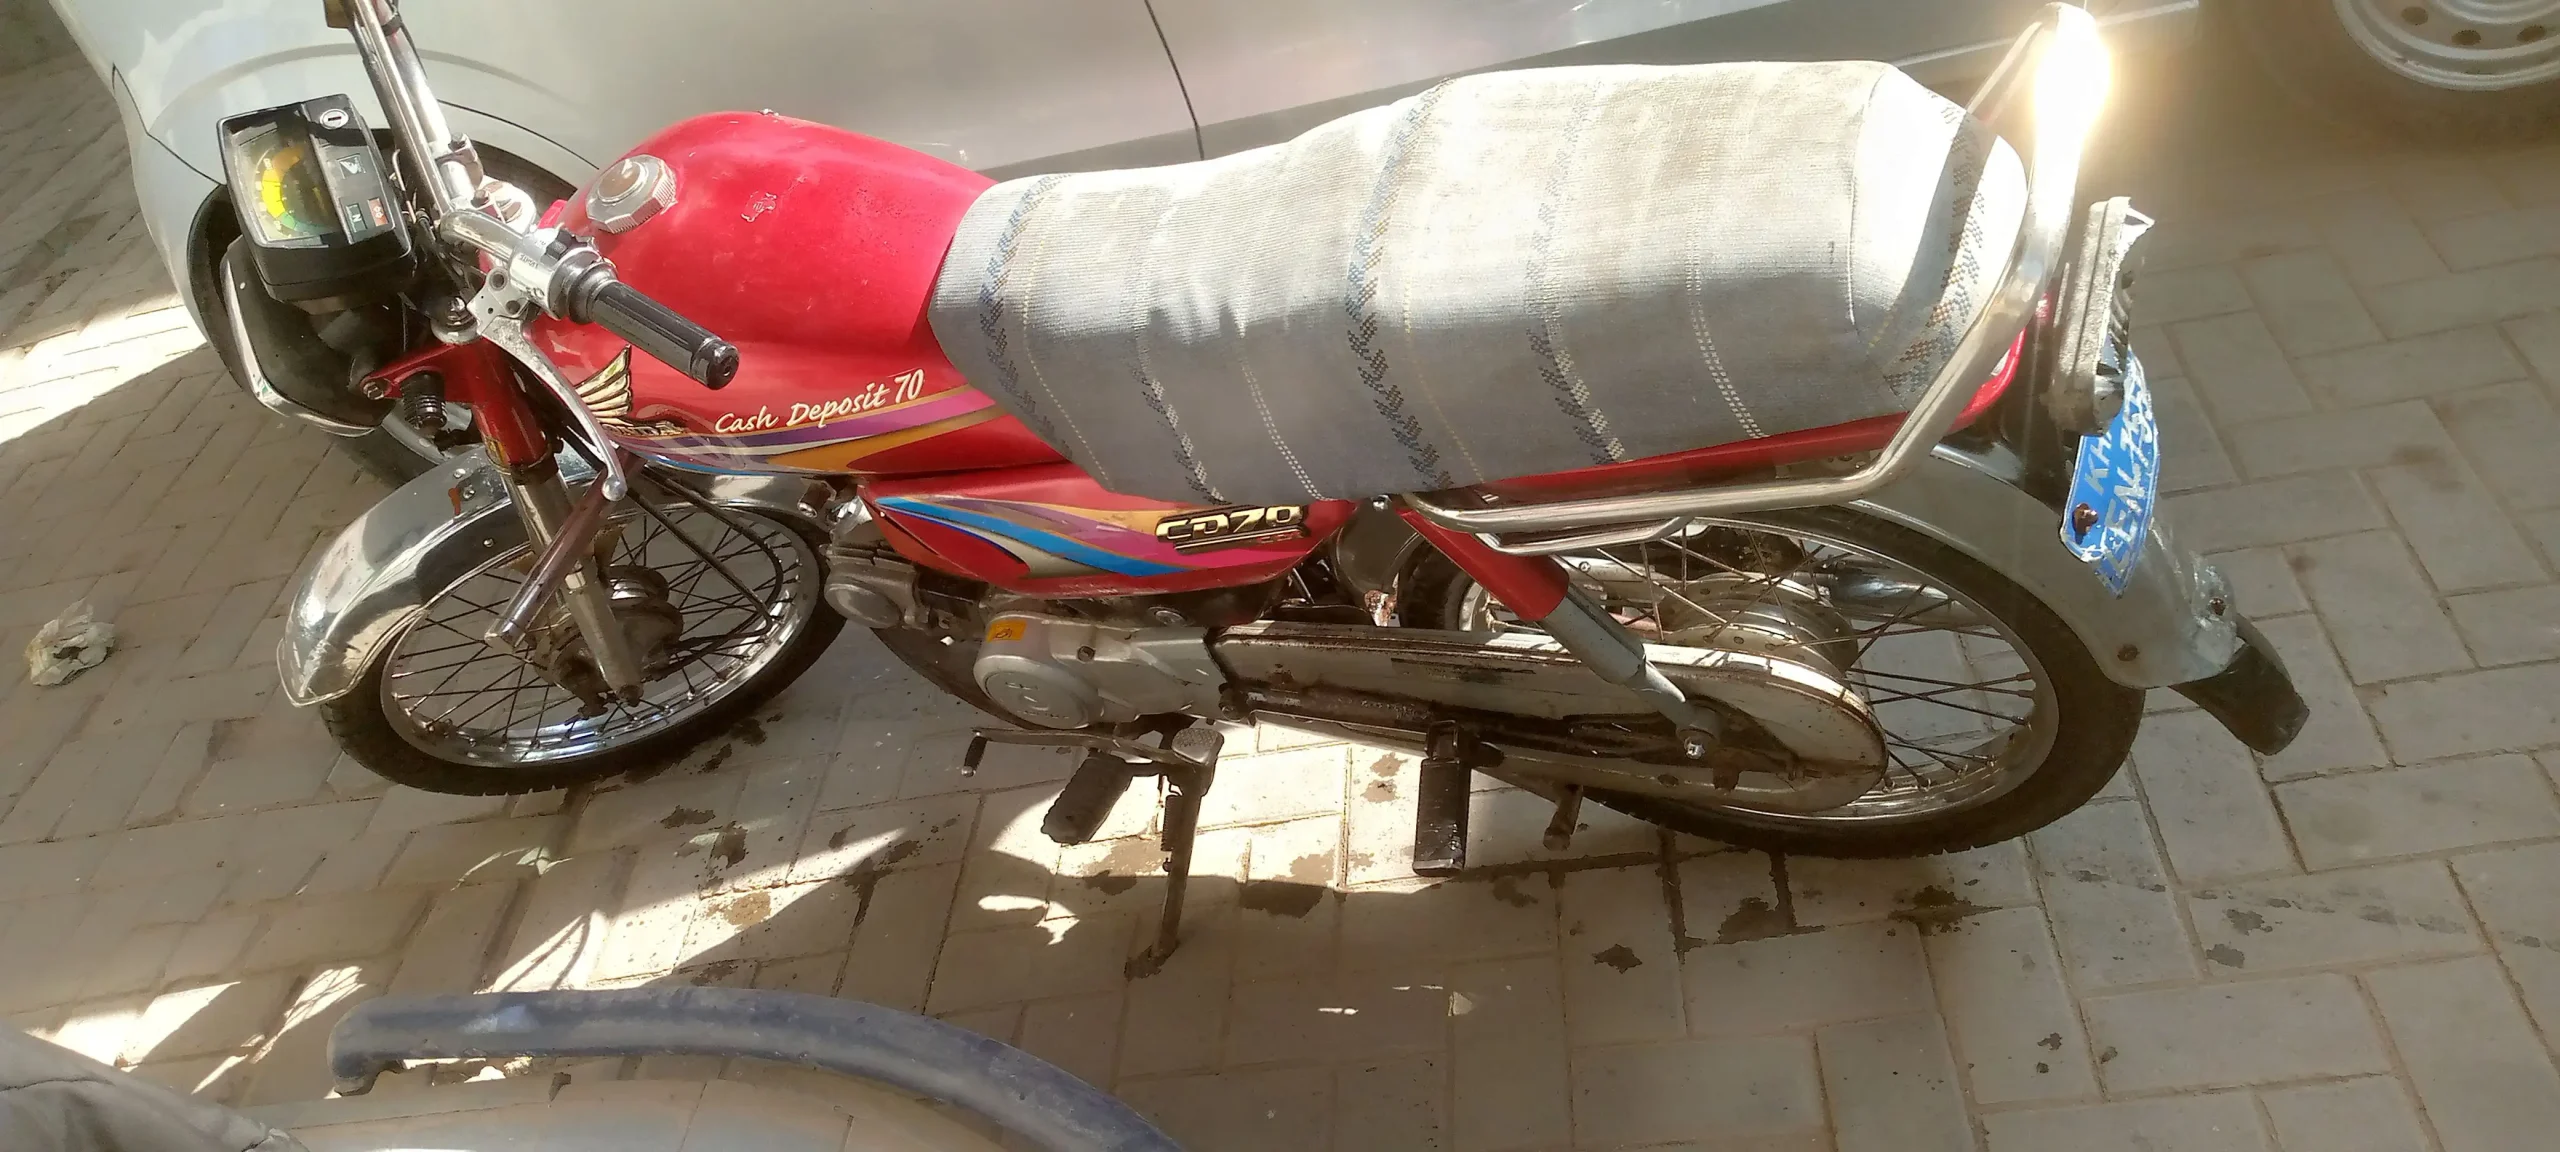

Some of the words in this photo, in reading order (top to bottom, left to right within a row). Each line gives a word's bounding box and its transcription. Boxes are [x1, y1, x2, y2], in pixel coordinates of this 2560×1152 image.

[352, 213, 363, 223] N
[715, 405, 779, 434] Cash
[788, 385, 889, 428] Deposit
[893, 368, 925, 402] 70
[1155, 505, 1304, 543] CD70
